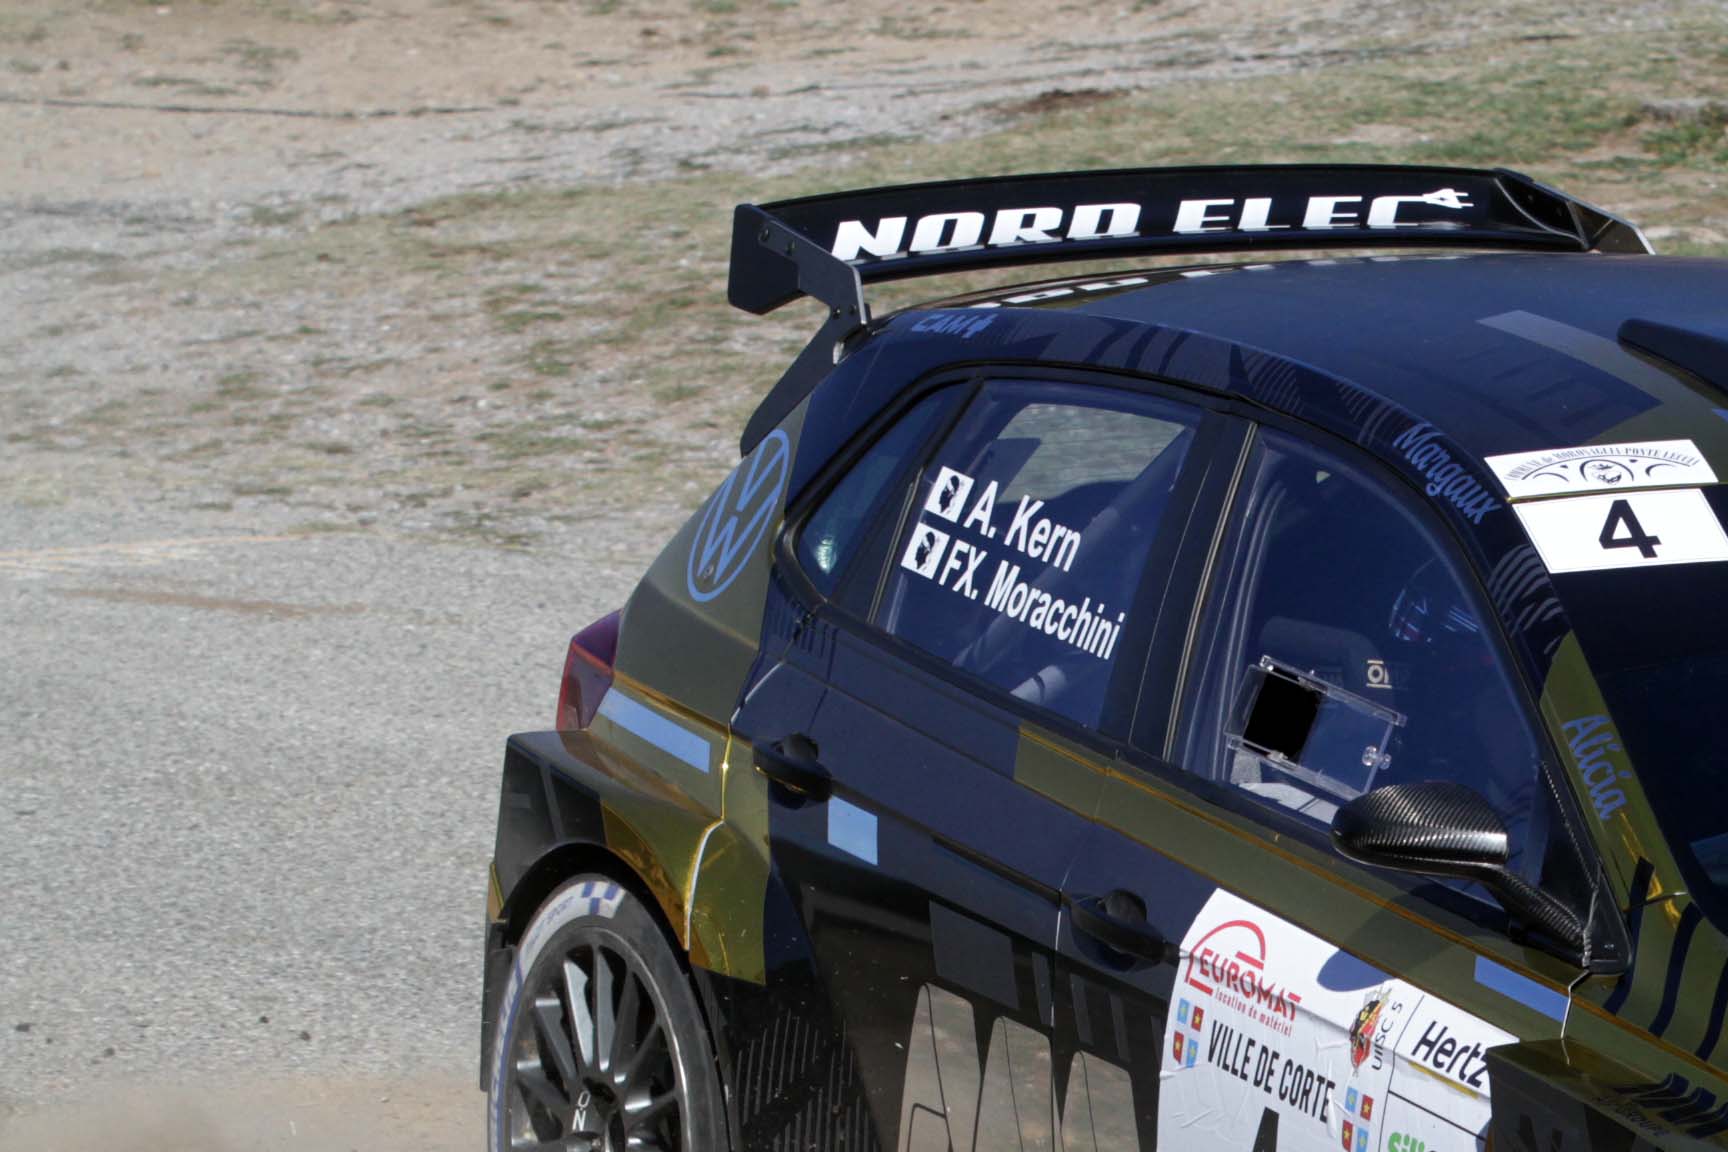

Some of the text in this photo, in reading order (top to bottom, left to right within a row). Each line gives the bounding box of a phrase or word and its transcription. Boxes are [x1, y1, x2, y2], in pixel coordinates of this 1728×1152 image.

[831, 195, 1430, 261] NORD ELEC
[1393, 423, 1502, 525] Margaux
[963, 480, 1081, 572] A. Kern
[1598, 499, 1662, 559] 4
[938, 539, 1125, 660] FX. Moracchini
[1562, 714, 1631, 820] Alicia
[1199, 947, 1302, 1021] EUROMAT
[1207, 1019, 1336, 1124] VILLE DE CORTE
[1410, 1020, 1488, 1088] Hertz
